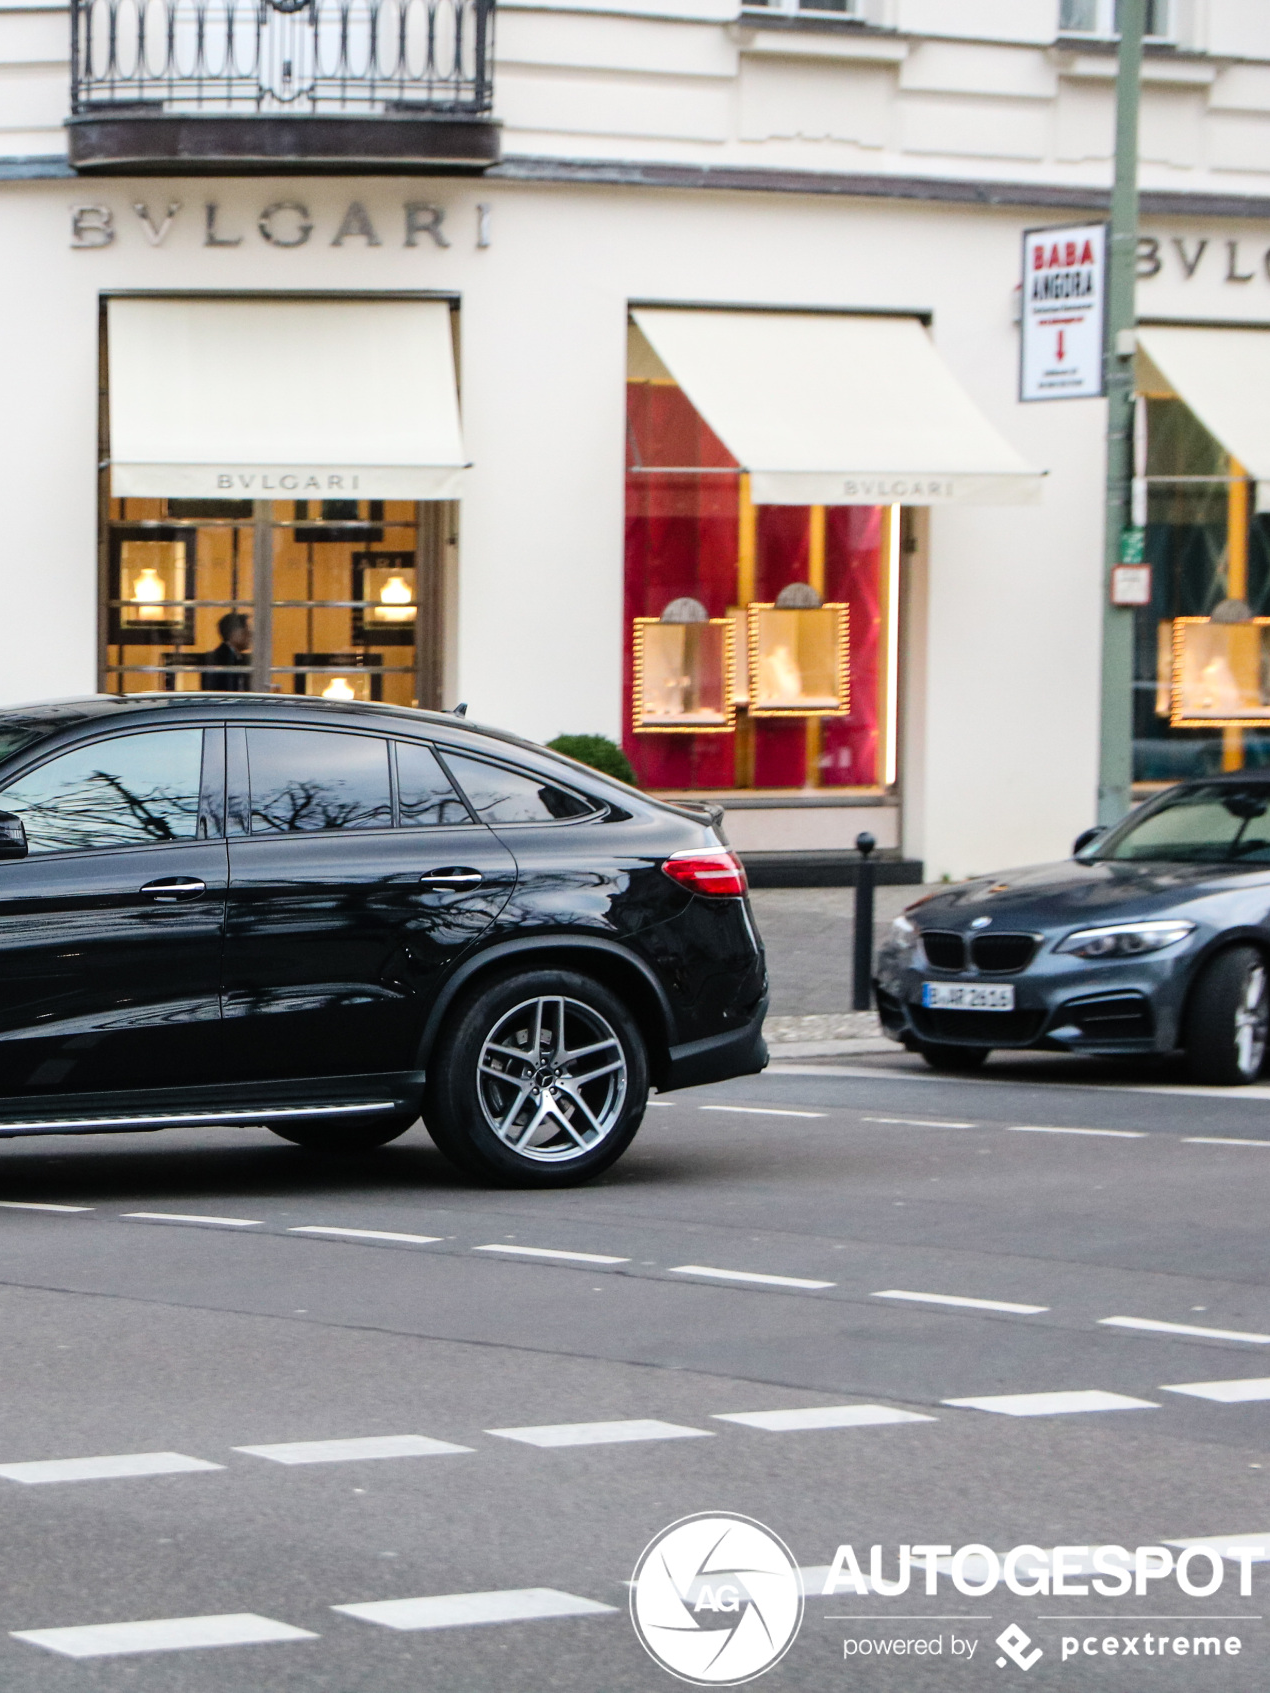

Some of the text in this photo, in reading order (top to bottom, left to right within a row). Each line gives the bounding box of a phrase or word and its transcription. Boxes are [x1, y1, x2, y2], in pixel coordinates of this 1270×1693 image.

[69, 202, 491, 249] BVLGARI
[1034, 239, 1094, 271] BABA
[1135, 236, 1270, 282] BVL
[217, 473, 360, 491] BVLGARI
[843, 479, 954, 497] BVLGARI
